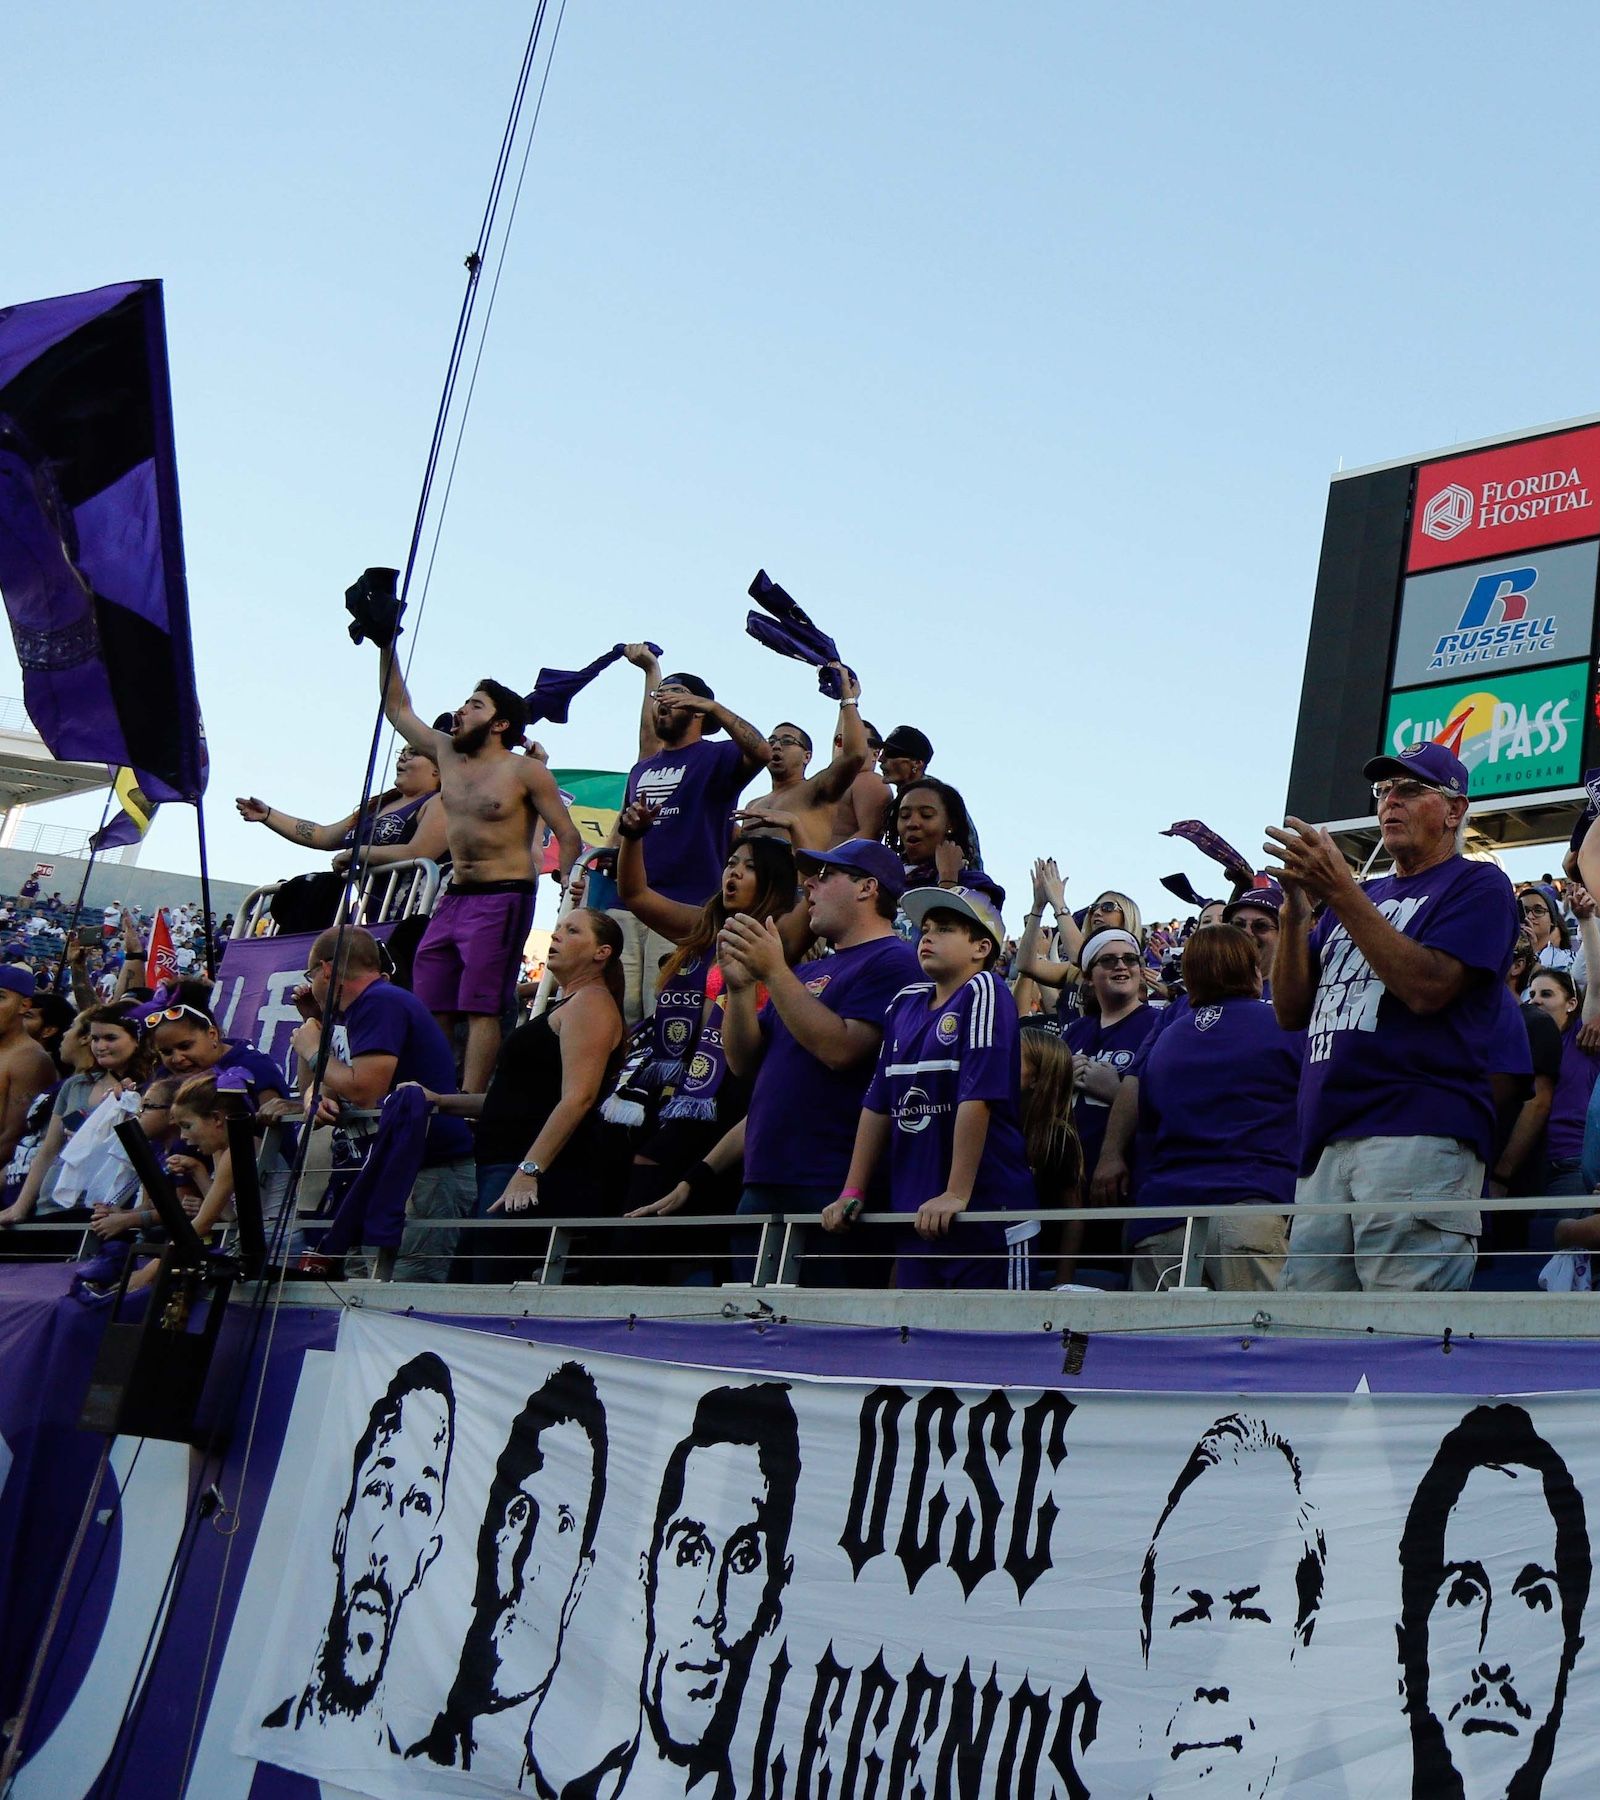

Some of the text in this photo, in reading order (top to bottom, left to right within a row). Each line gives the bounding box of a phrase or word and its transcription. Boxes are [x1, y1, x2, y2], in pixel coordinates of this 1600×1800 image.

[1480, 467, 1581, 505] FLORIDA
[1477, 489, 1593, 529] HOSPITAL
[1427, 637, 1555, 671] ATHLETIC
[1432, 616, 1558, 655] RUSSELL
[1488, 698, 1570, 764] PASS
[1472, 766, 1565, 787] LL PROGRAM
[660, 992, 701, 1006] OCSC
[1308, 980, 1386, 1038] IRM
[701, 1028, 724, 1046] CS
[1310, 1031, 1334, 1064] 121
[838, 1385, 1078, 1606] OCSC
[749, 1635, 1102, 1799] LEGENDS
